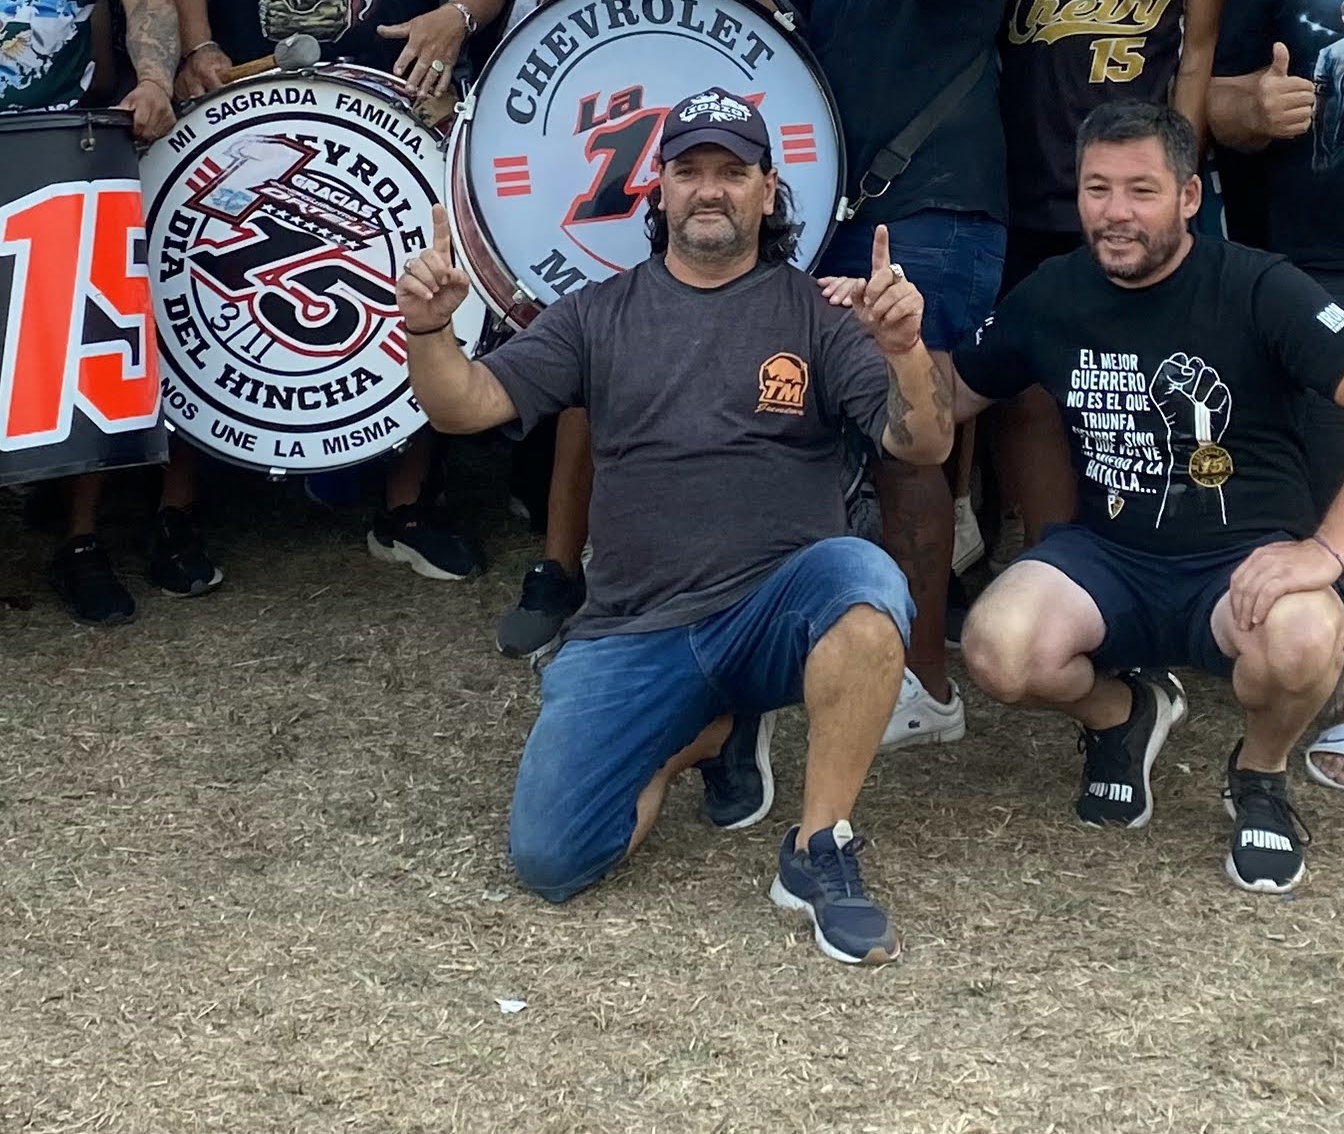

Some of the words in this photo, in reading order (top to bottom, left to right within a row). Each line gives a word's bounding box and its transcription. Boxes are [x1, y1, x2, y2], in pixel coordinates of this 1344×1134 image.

[1088, 36, 1147, 84] 15
[168, 124, 197, 154] MI
[205, 87, 318, 126] SAGRADA
[335, 93, 426, 161] FAMILIA.
[573, 84, 644, 137] La
[291, 173, 379, 219] GRACIAS
[160, 210, 193, 284] DIA
[163, 294, 209, 370] DEL
[1080, 348, 1098, 370] EL
[1100, 353, 1139, 372] MEJOR
[215, 365, 384, 412] HINCHA
[765, 379, 802, 403] TM
[1071, 369, 1146, 393] GUERRERO
[161, 376, 200, 422] NOS
[210, 419, 258, 452] UNE
[274, 439, 306, 459] LA
[322, 415, 400, 456] MISMA
[1067, 391, 1084, 408] NO
[1087, 392, 1103, 406] ES
[1107, 393, 1122, 411] EL
[1125, 394, 1151, 412] QUE
[1081, 411, 1136, 431] TRIUNFA
[1085, 460, 1157, 494] BATALLA...
[1133, 459, 1144, 473] A
[1146, 461, 1163, 476] LA
[1241, 829, 1294, 852] PUMA
